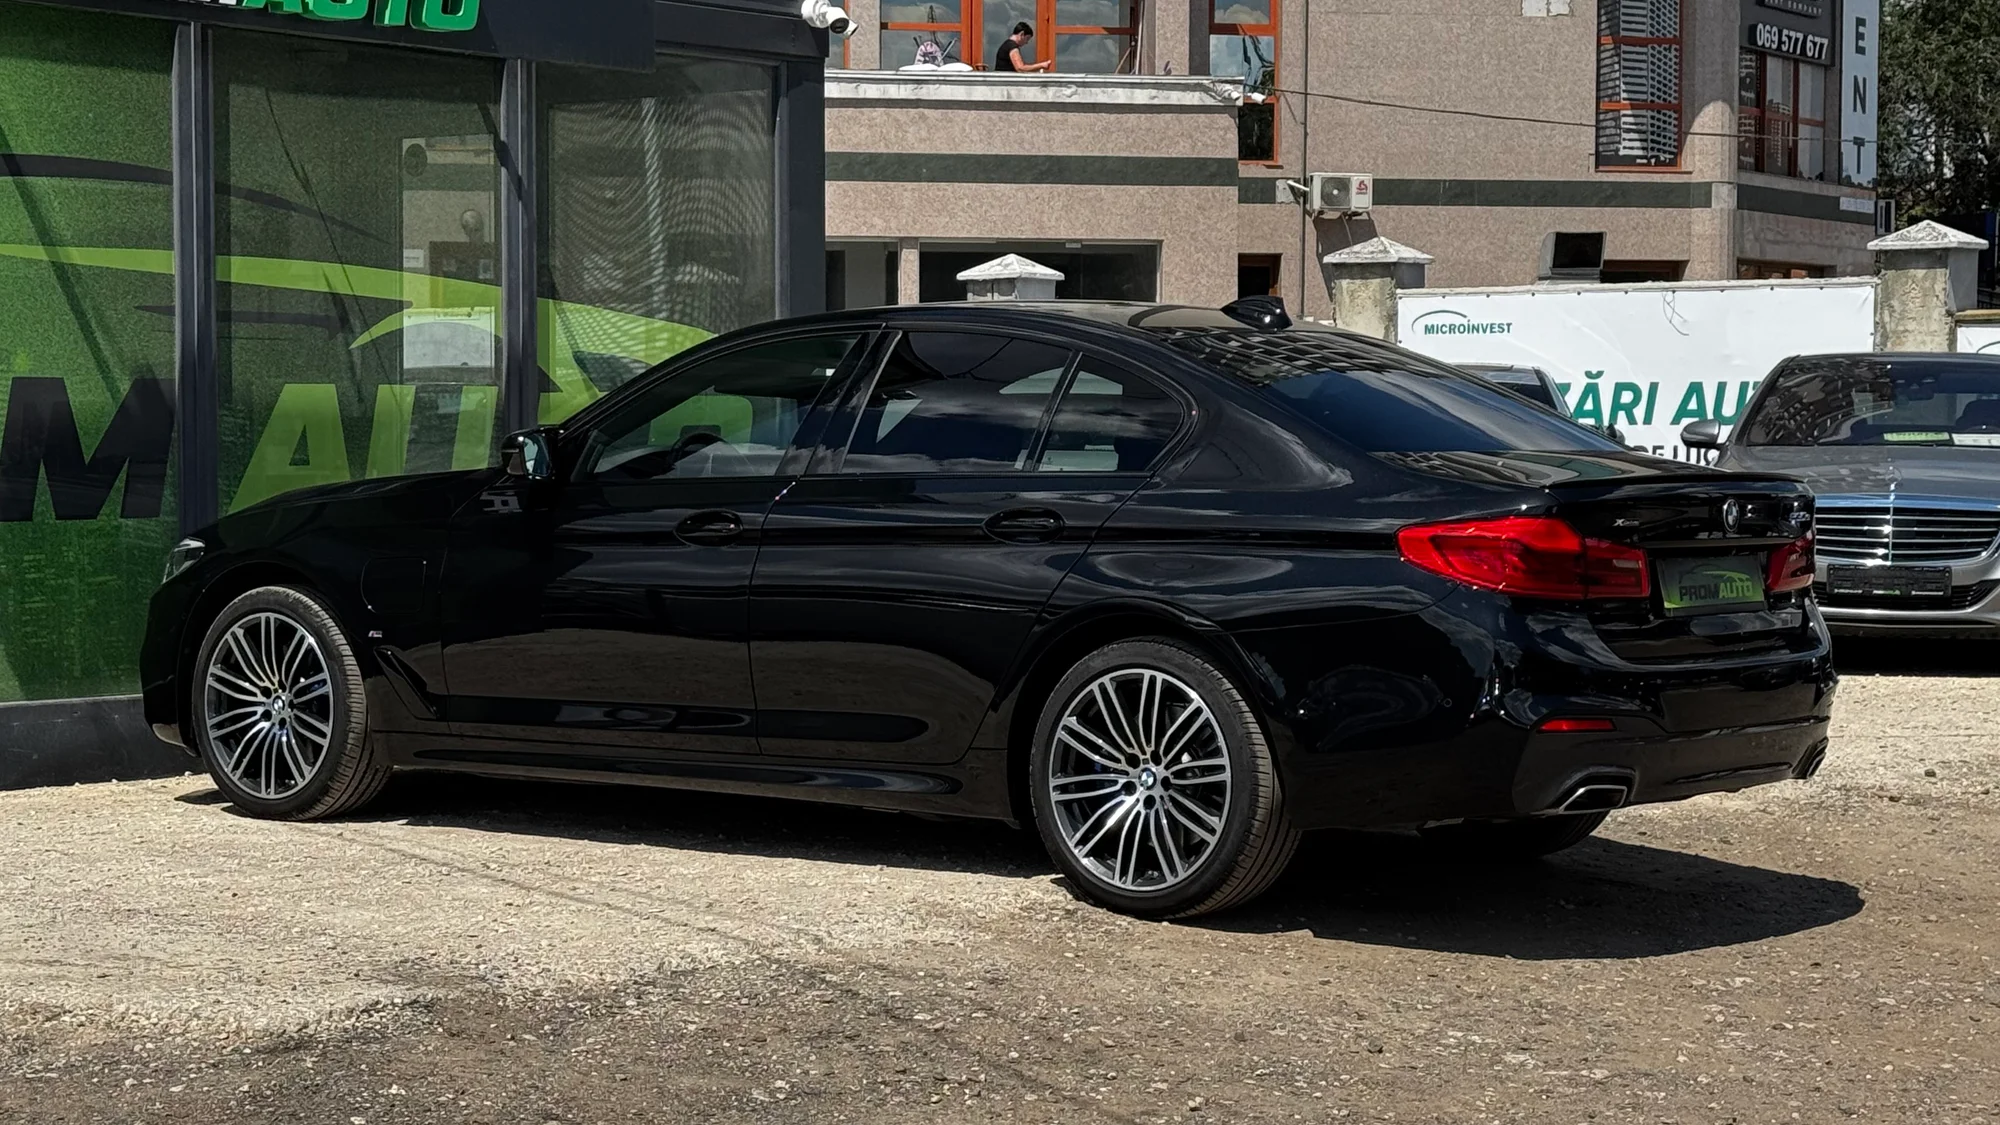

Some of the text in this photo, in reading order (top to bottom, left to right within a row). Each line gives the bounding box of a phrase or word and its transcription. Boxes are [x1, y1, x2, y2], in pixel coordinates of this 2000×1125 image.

[1756, 22, 1829, 61] 069 577 677
[1557, 370, 1762, 426] ĂRI AU
[1679, 581, 1753, 602] PROMAUTO
